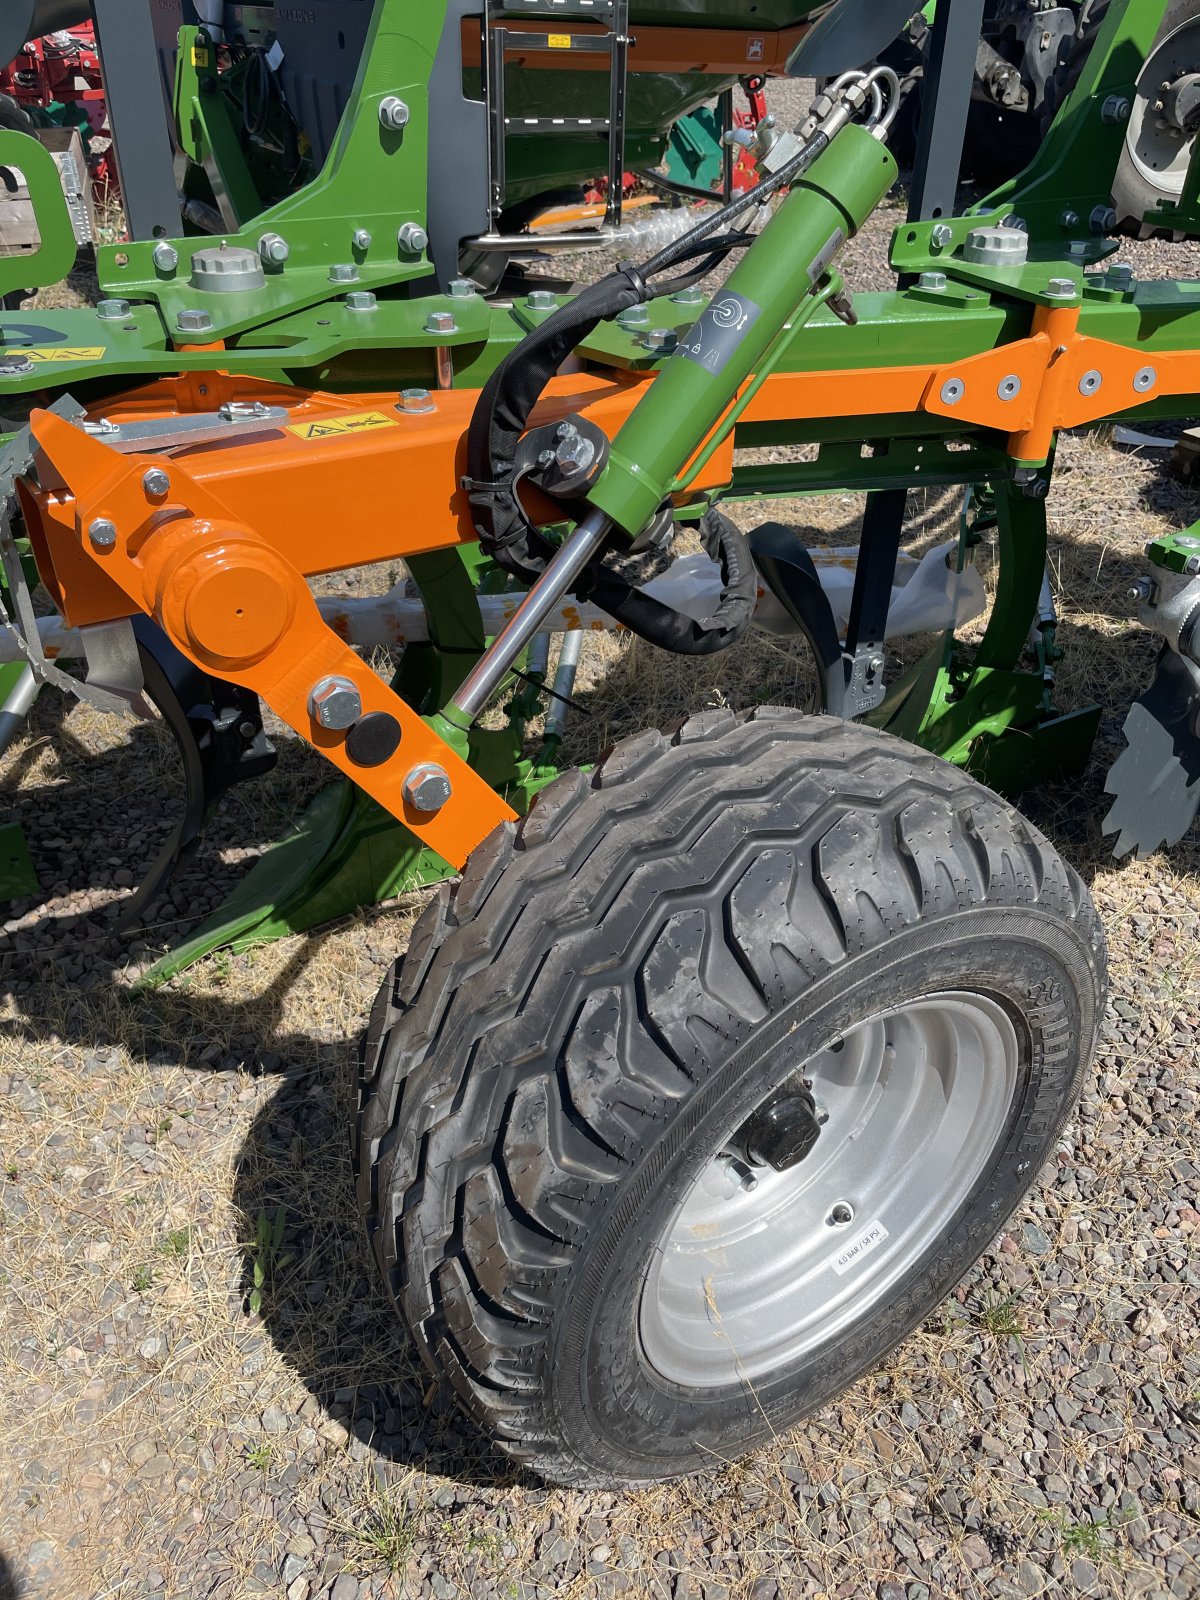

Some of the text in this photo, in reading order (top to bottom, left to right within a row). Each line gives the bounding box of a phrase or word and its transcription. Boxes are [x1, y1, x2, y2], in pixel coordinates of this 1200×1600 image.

[276, 9, 315, 23] AMAZONE
[1016, 999, 1071, 1152] ALLIANCE
[838, 1256, 848, 1266] 4,0
[847, 1246, 860, 1259] BAR
[863, 1236, 871, 1246] 58
[870, 1229, 880, 1240] PSI
